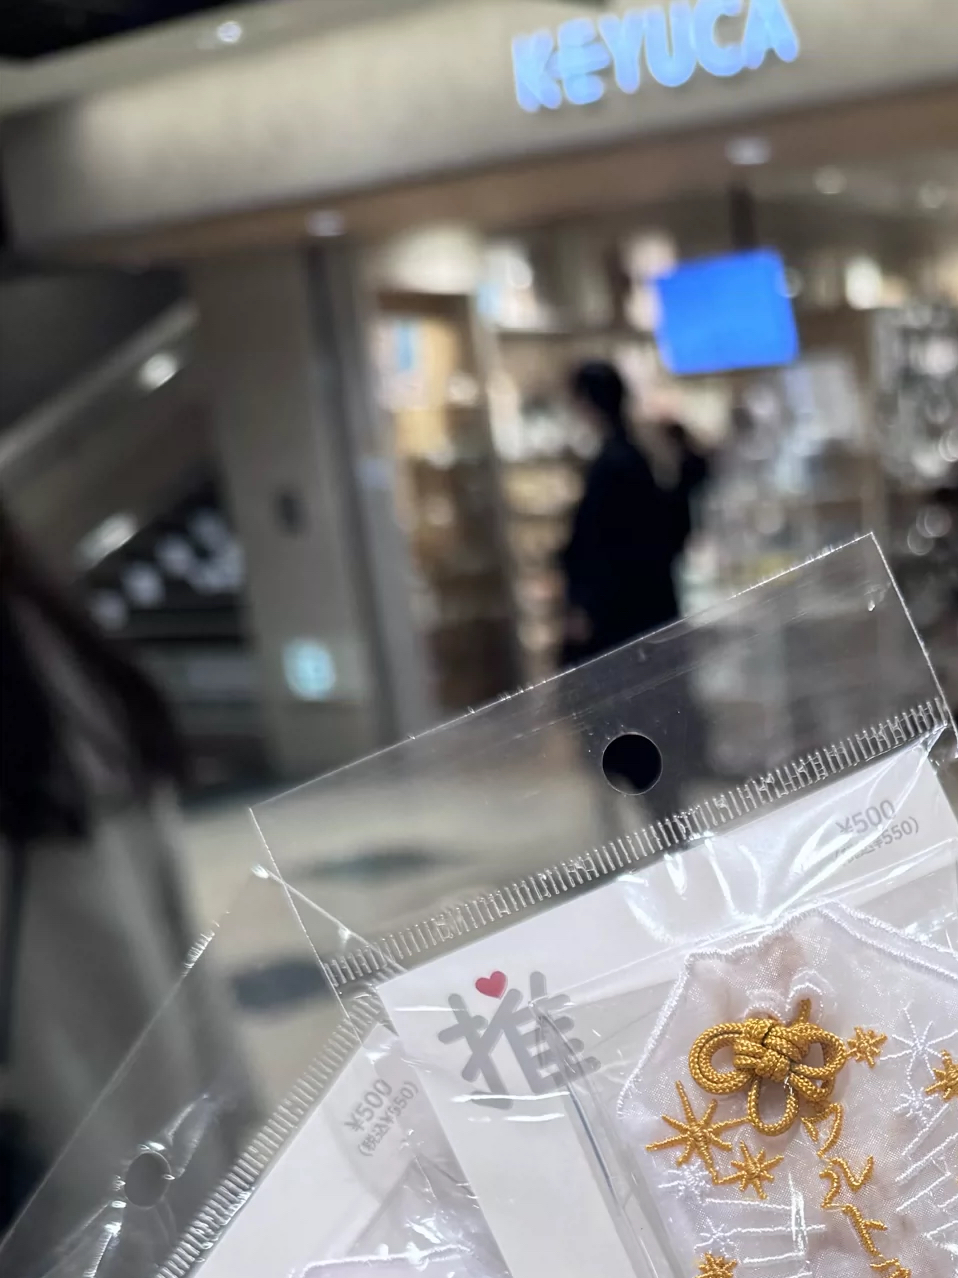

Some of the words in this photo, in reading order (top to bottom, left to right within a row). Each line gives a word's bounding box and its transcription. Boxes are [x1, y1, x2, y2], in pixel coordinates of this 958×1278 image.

[511, 0, 799, 112] KEYUCA
[835, 799, 895, 834] ¥500
[438, 971, 601, 1110] 推
[344, 1079, 392, 1132] ¥500
